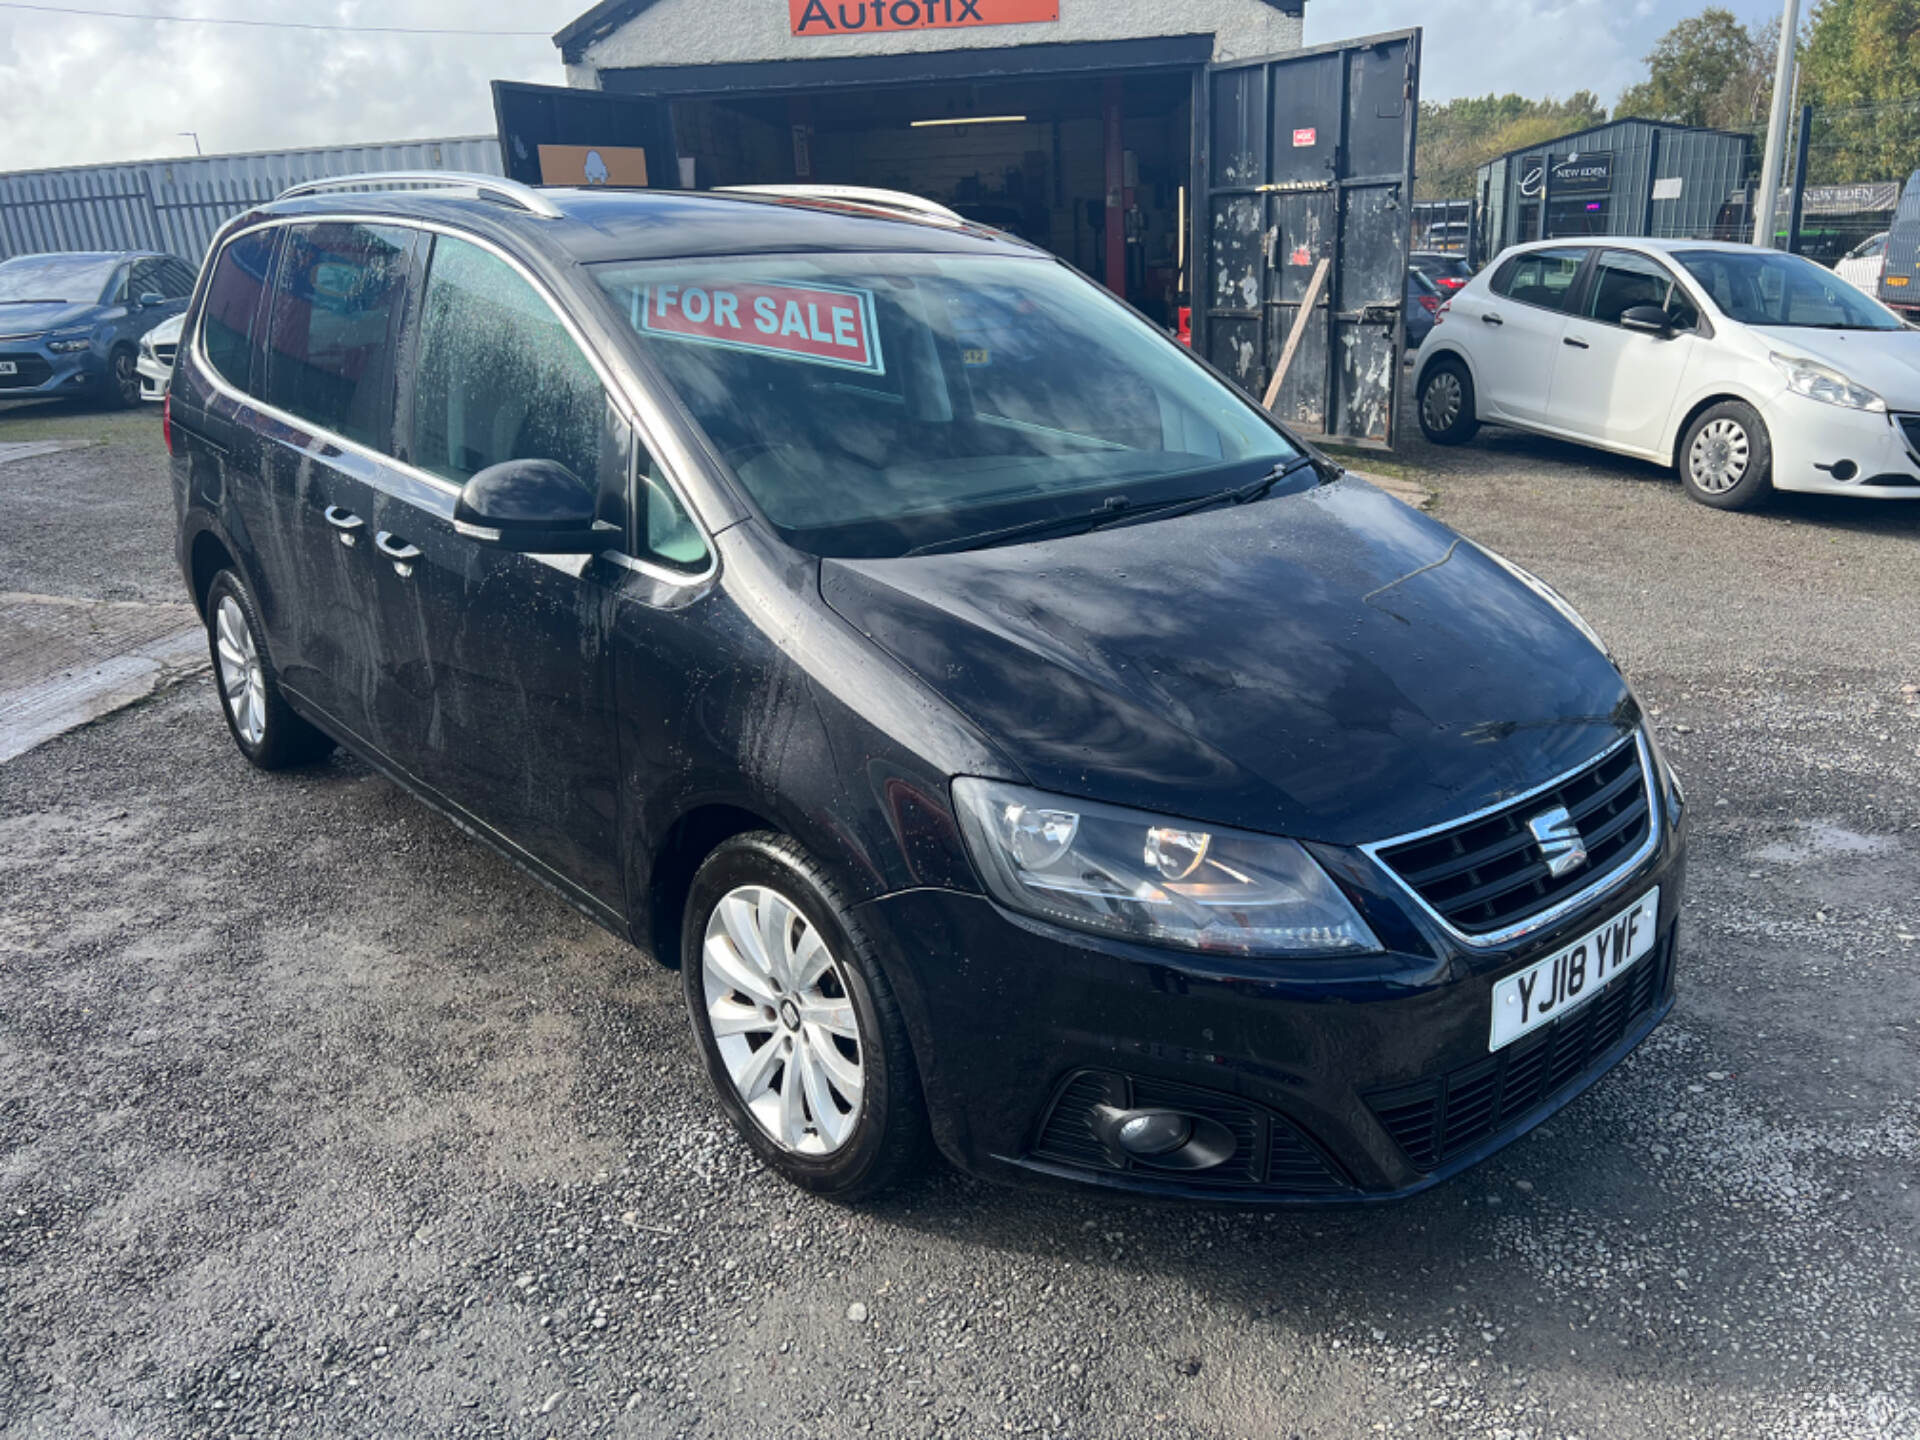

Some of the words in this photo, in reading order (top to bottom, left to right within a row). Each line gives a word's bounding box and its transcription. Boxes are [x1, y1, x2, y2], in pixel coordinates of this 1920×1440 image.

[1556, 168, 1580, 178] NEW
[1580, 166, 1607, 177] EDEN
[656, 285, 742, 329] FOR
[753, 296, 859, 348] SALE
[1517, 945, 1588, 1024] YJ18
[1596, 904, 1643, 979] YWF
